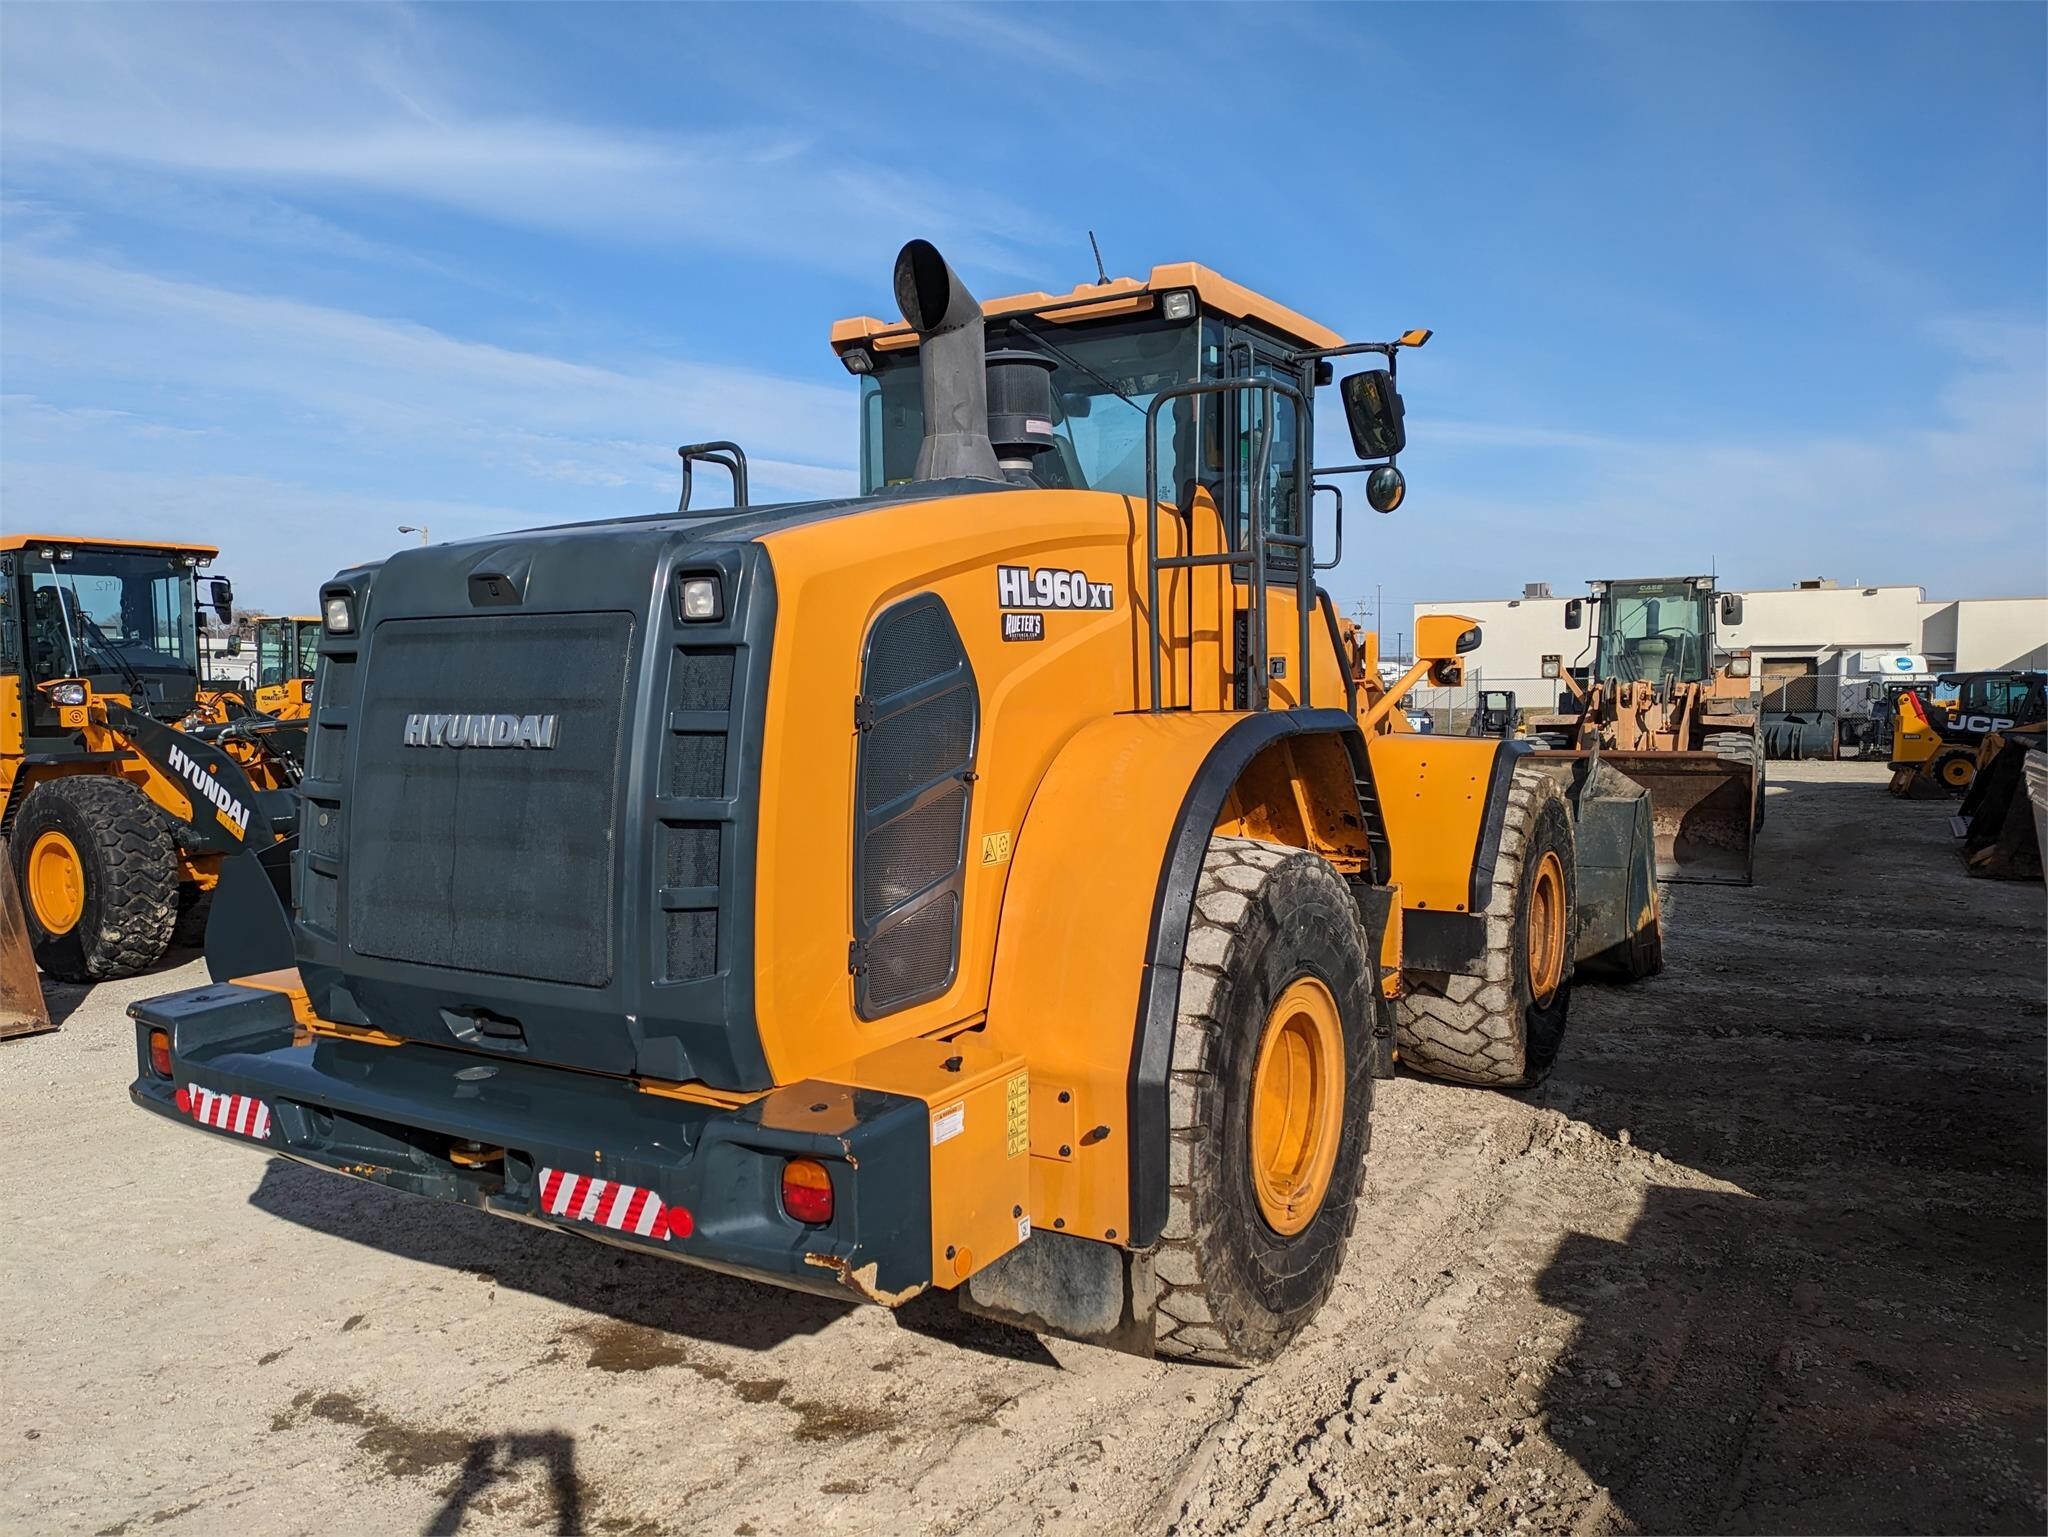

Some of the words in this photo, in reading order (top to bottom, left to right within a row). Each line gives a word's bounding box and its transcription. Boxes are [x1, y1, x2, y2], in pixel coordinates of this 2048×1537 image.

[1005, 614, 1041, 635] RUETER'S
[403, 713, 559, 749] HYUNDAI
[168, 743, 250, 831] HYUNDAI
